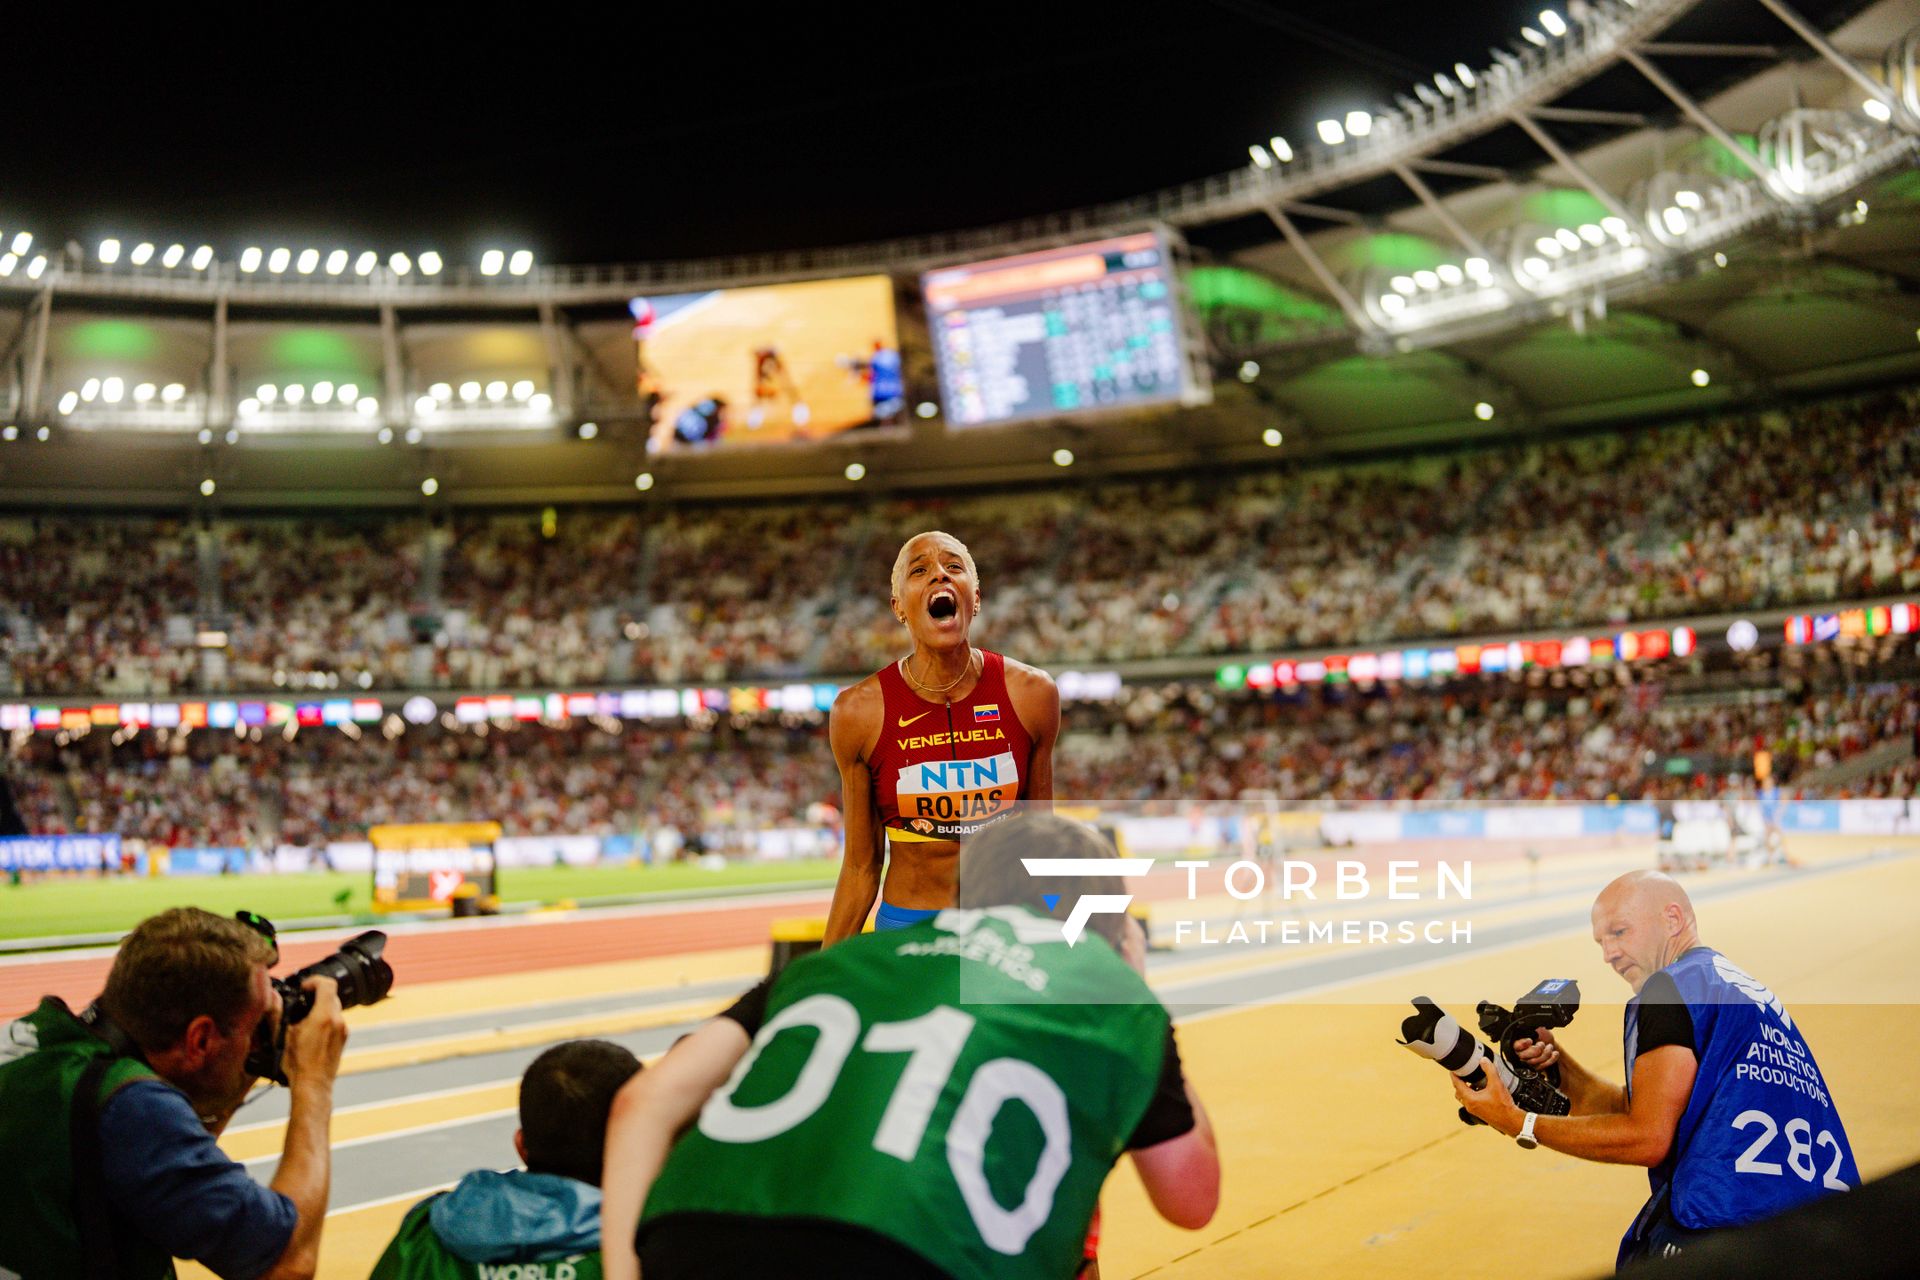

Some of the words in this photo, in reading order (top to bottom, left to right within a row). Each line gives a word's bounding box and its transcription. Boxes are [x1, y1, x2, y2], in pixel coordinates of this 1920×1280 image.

[898, 728, 1005, 751] VENEZUELA
[921, 757, 998, 791] NTN
[916, 789, 1003, 819] ROJAS
[1760, 1022, 1805, 1058] WORLD
[1746, 1042, 1819, 1085] ATHLETICS
[1736, 1063, 1829, 1108] PRODUCTIONS
[698, 993, 1072, 1256] 010
[1731, 1109, 1850, 1192] 282
[478, 1262, 577, 1280] WORLD
